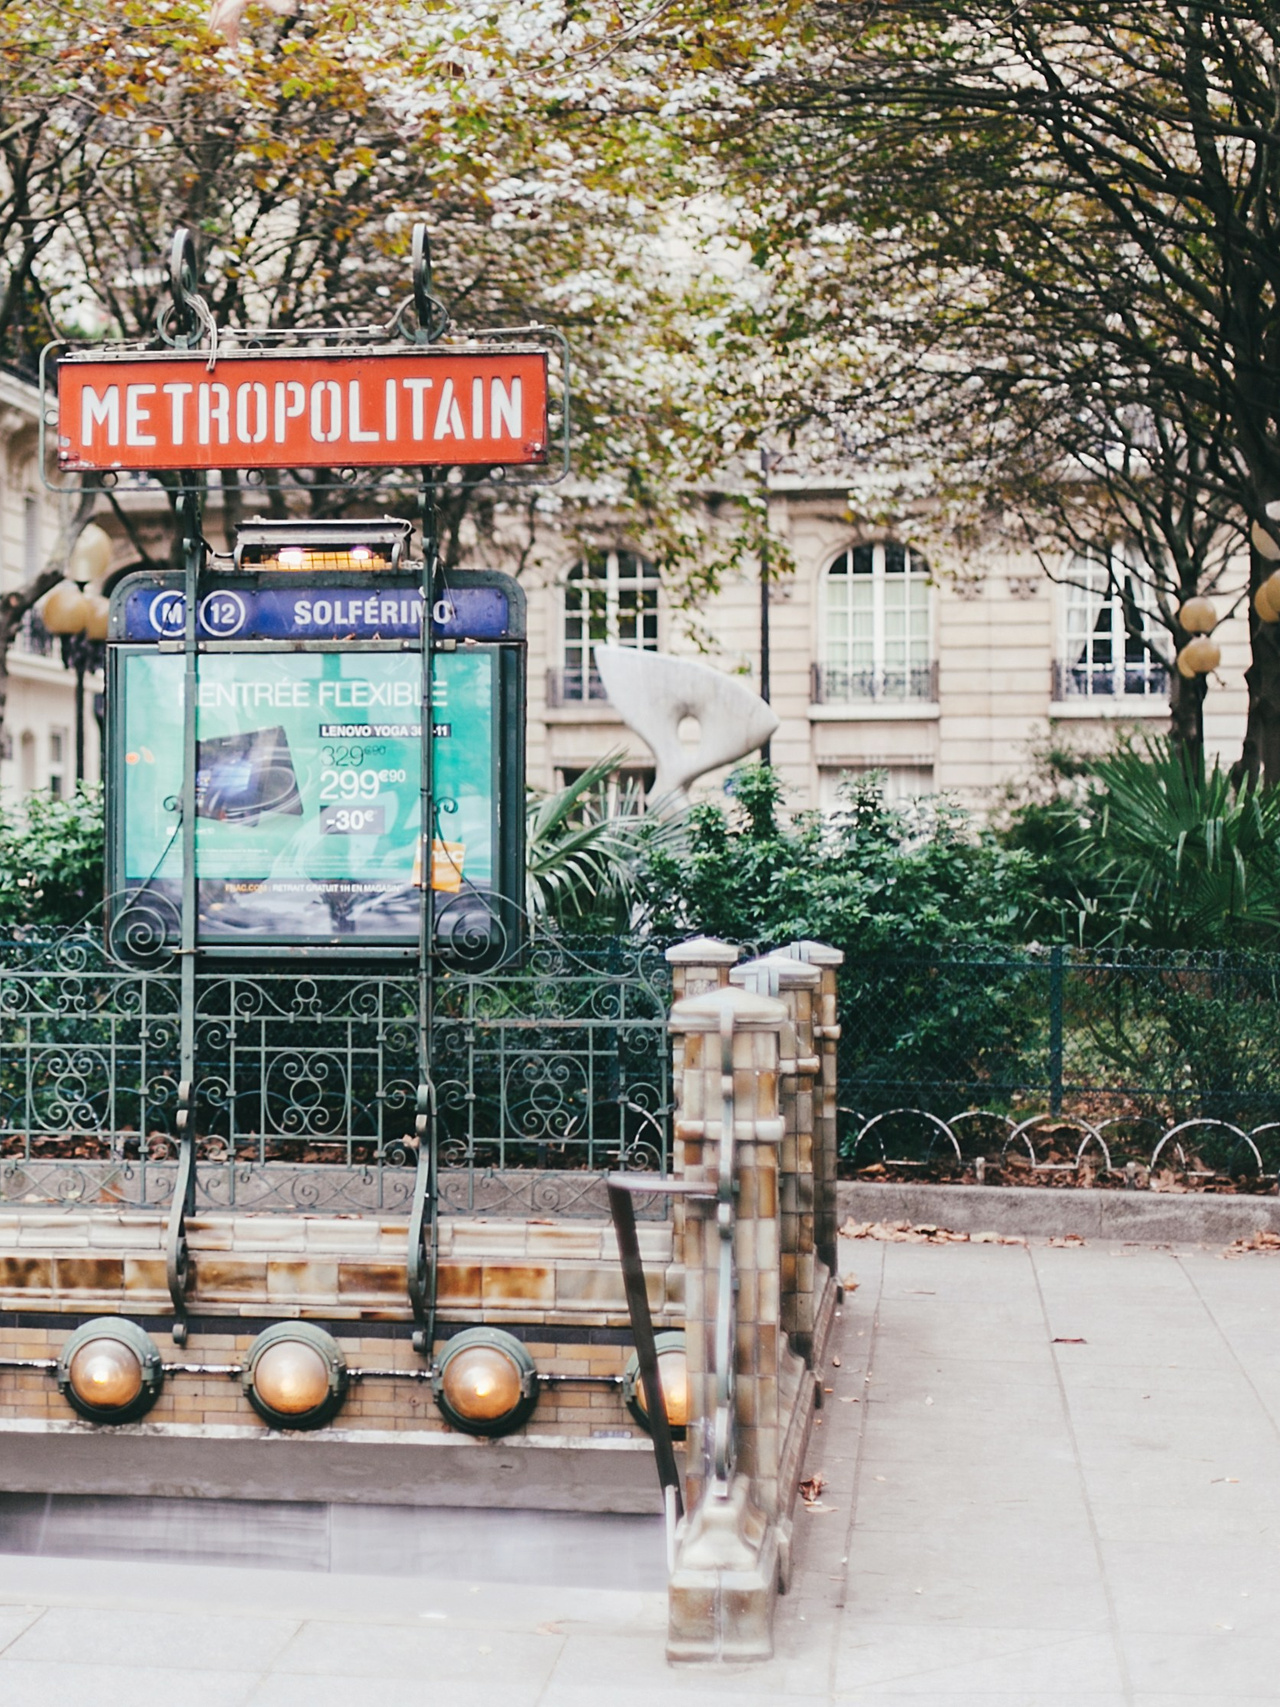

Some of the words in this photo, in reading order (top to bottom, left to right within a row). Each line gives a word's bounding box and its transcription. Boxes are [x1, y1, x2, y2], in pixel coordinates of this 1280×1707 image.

[81, 376, 523, 446] METROPOLITAIN
[162, 602, 182, 624] M
[210, 602, 236, 624] 12
[322, 725, 372, 737] LENOVO
[373, 725, 410, 737] YOGA
[273, 884, 304, 893] RETRAIT
[306, 884, 338, 892] GRATUIT
[352, 884, 362, 892] EN
